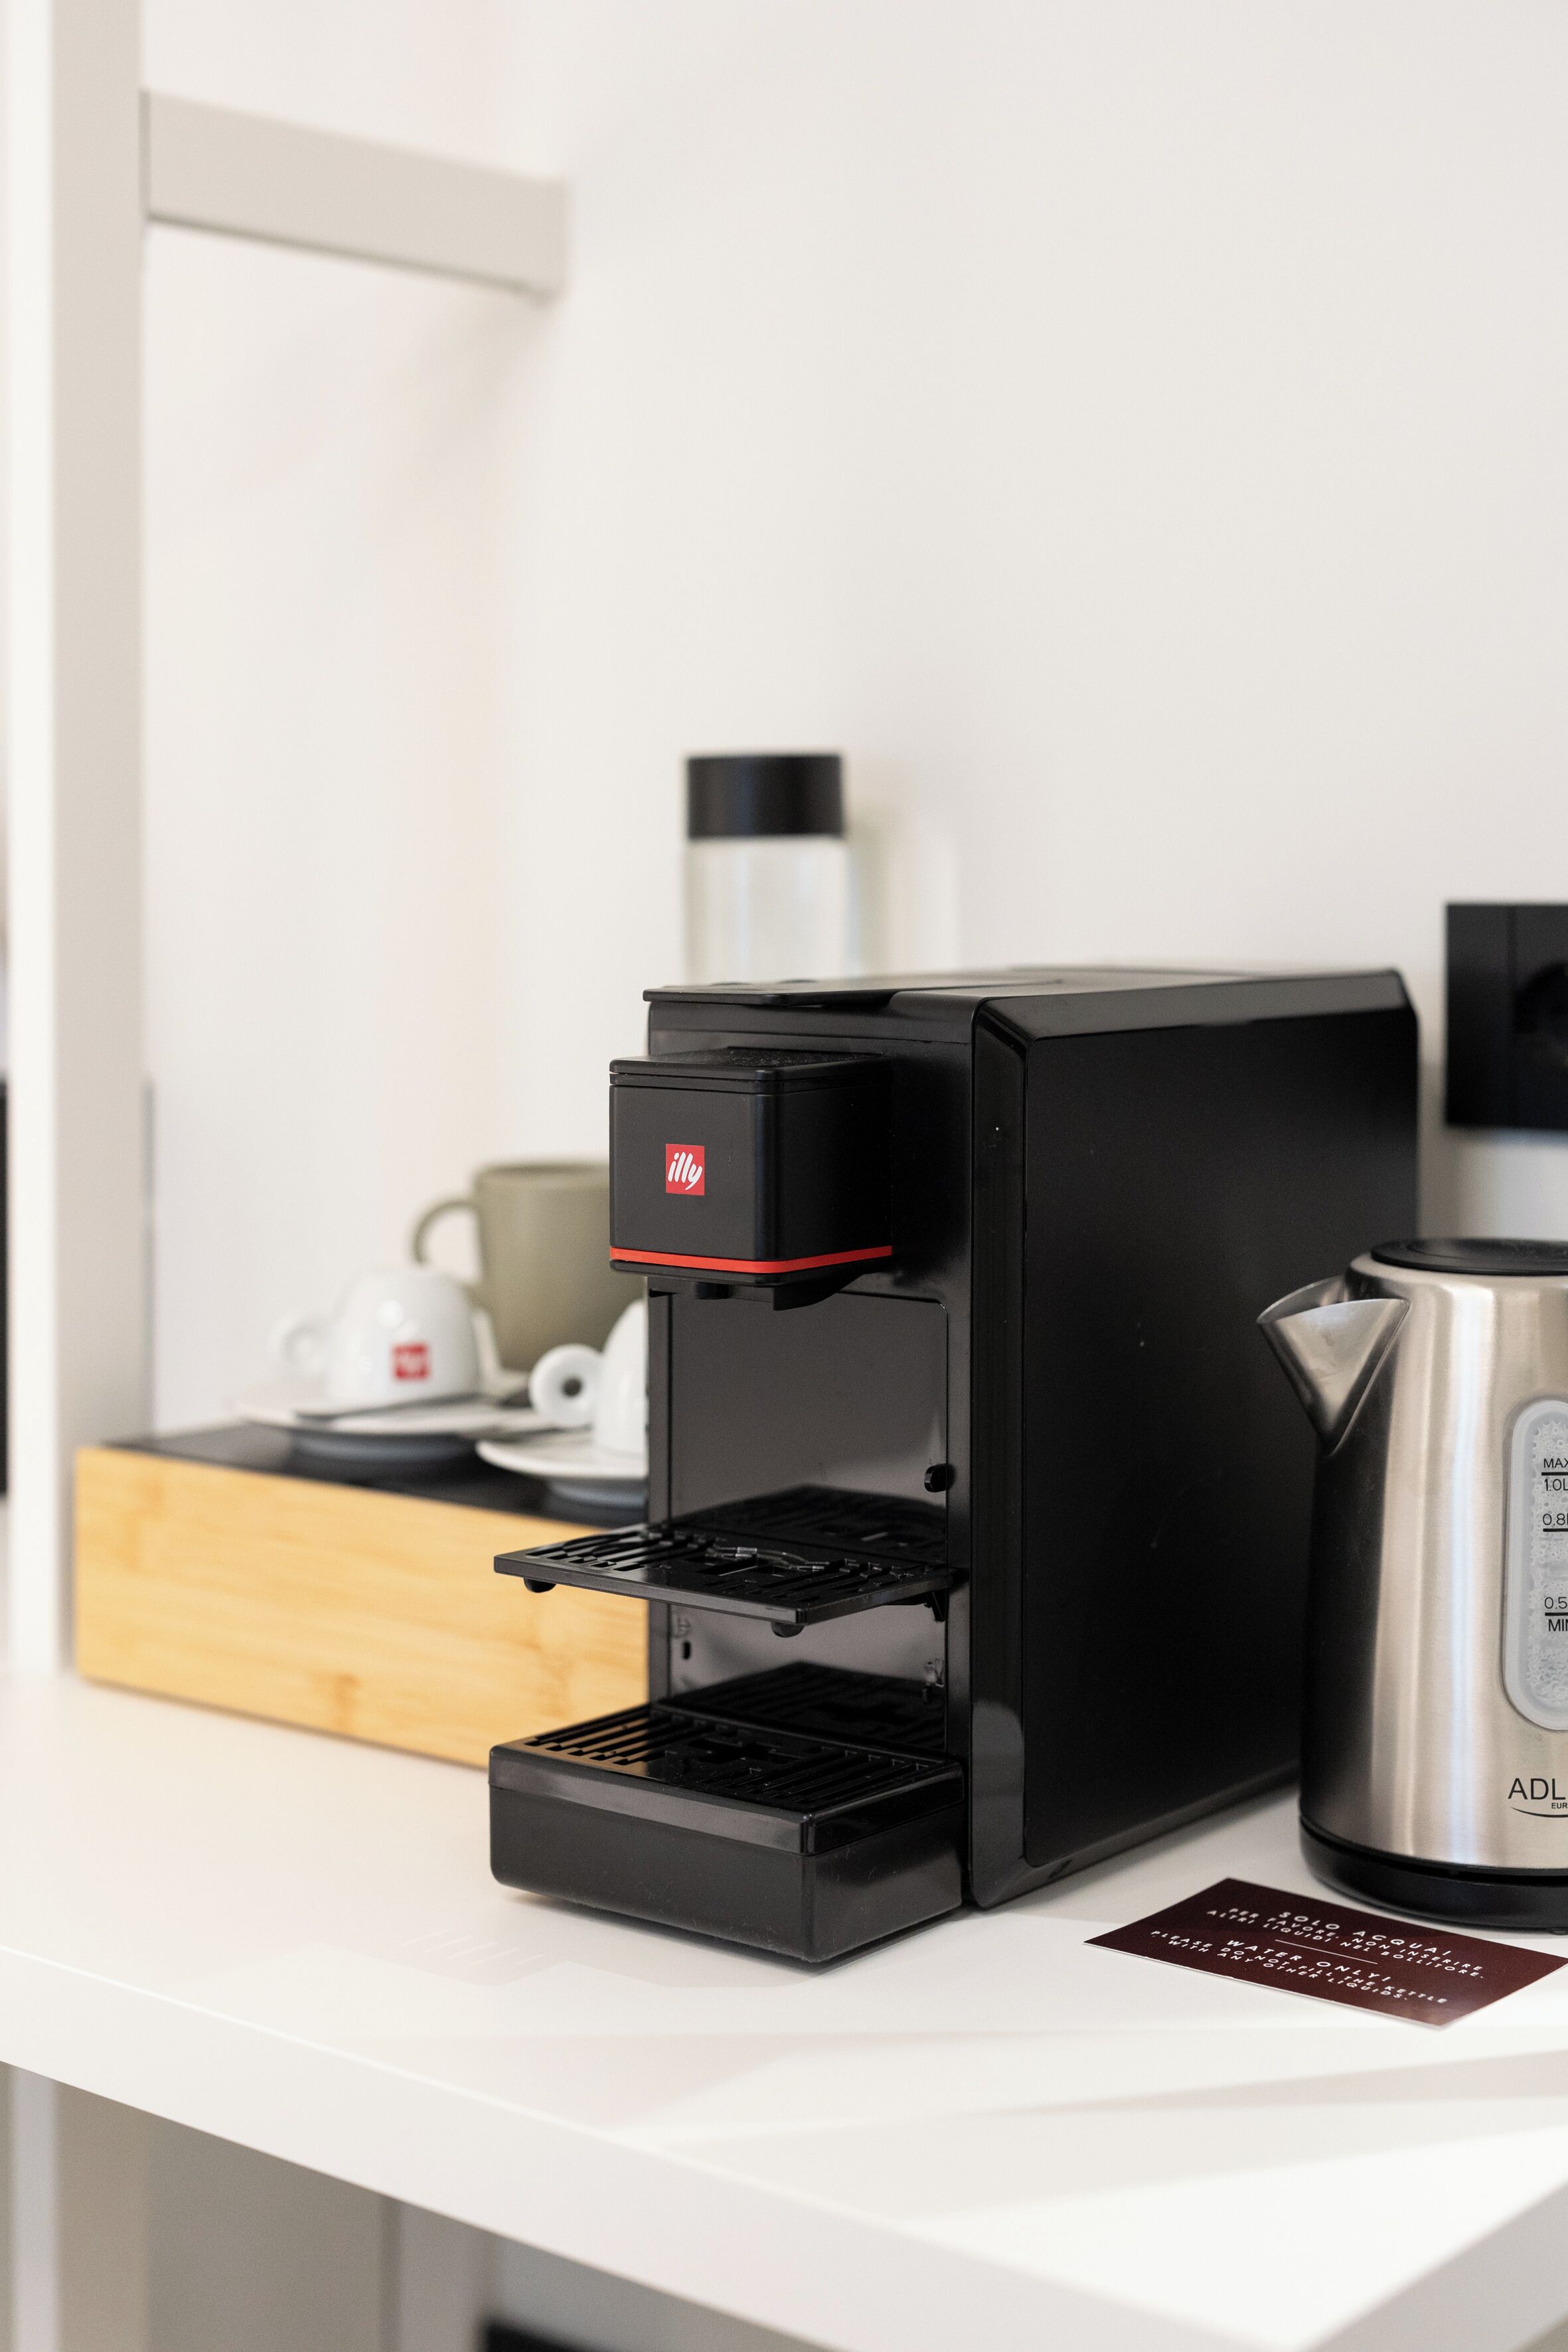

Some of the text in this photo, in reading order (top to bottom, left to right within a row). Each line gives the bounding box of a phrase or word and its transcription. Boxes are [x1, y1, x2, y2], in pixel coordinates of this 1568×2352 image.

[668, 1152, 702, 1190] illy
[1544, 1478, 1568, 1491] 1.0L
[1542, 1513, 1568, 1526] 0.8
[1206, 1910, 1484, 1978] ALTRI LIQUIDI NEL BOLLITORE.
[1229, 1908, 1259, 1918] PER
[1352, 1938, 1390, 1949] NON
[1399, 1949, 1482, 1970] INSERIRE
[1279, 1912, 1451, 1956] SOLO ACQUA!
[1150, 1930, 1212, 1948] PLEASE
[1255, 1956, 1290, 1966] NOT
[1298, 1966, 1332, 1976] FILL
[1344, 1976, 1375, 1986] THE
[1384, 1986, 1447, 2003] KETTLE
[1168, 1940, 1209, 1952] WITH
[1217, 1953, 1253, 1962] ANY
[1263, 1963, 1318, 1978] OTHER
[1227, 1940, 1391, 1982] WATER ONLY!
